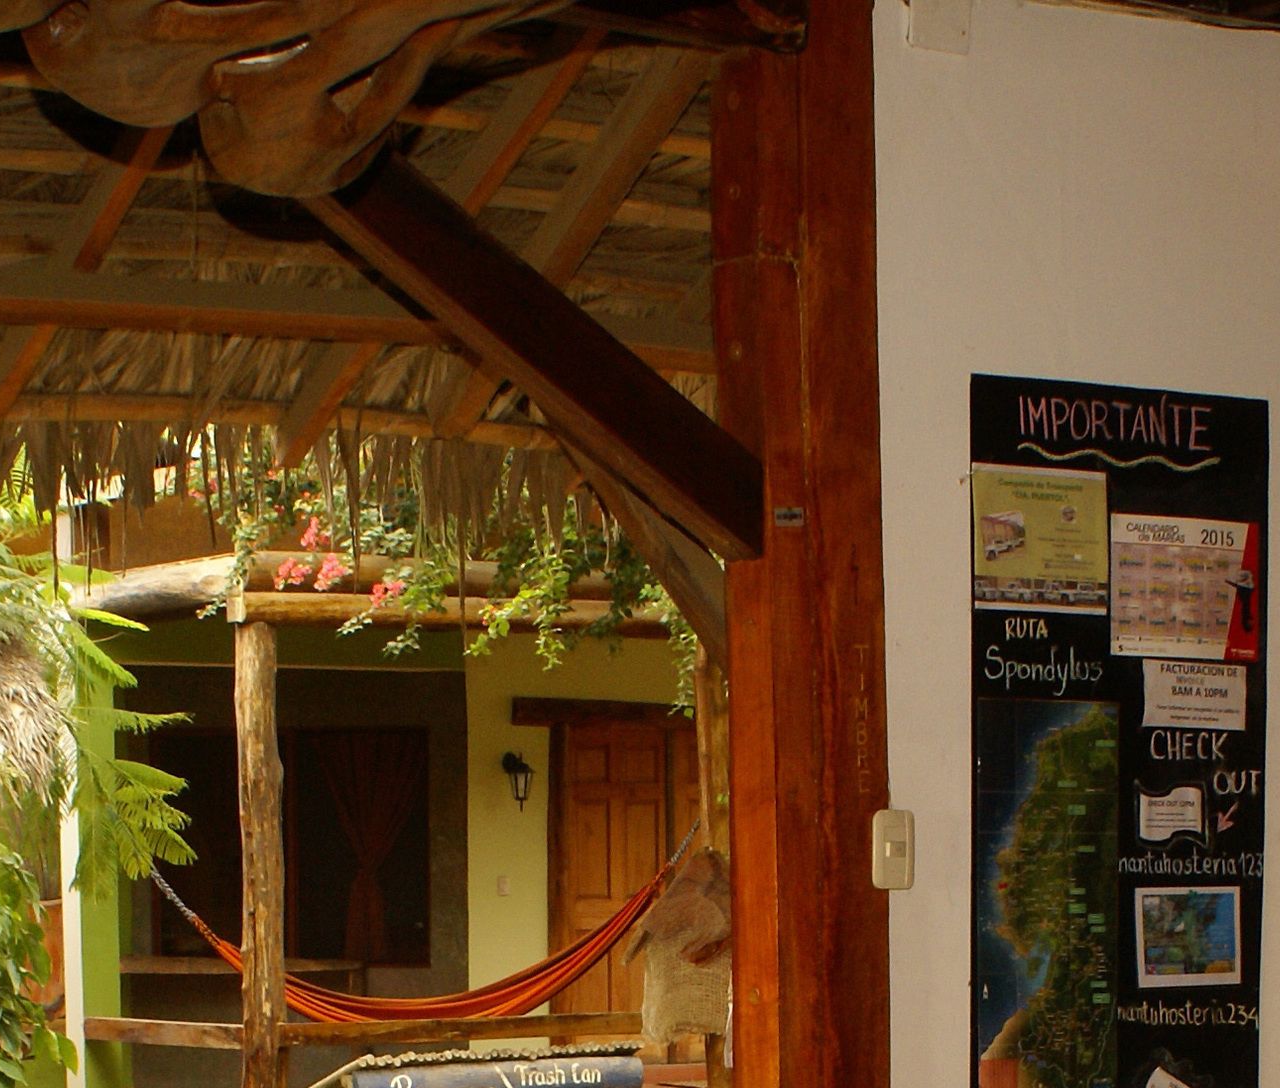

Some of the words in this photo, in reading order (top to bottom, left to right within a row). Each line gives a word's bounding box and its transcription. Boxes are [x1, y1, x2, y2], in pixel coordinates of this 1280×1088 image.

[1017, 394, 1213, 452] IMPORTANTE
[1126, 521, 1180, 535] CALENDARIO
[1200, 529, 1234, 547] 2015
[1005, 617, 1049, 641] RUTA
[983, 644, 1104, 697] Spondylus
[1226, 667, 1238, 677] DE
[1171, 686, 1193, 697] 8AM
[1195, 687, 1202, 697] A
[1150, 729, 1228, 761] CHECK
[1212, 769, 1262, 796] OUT
[513, 1063, 566, 1088] Trash
[570, 1062, 602, 1085] Can
